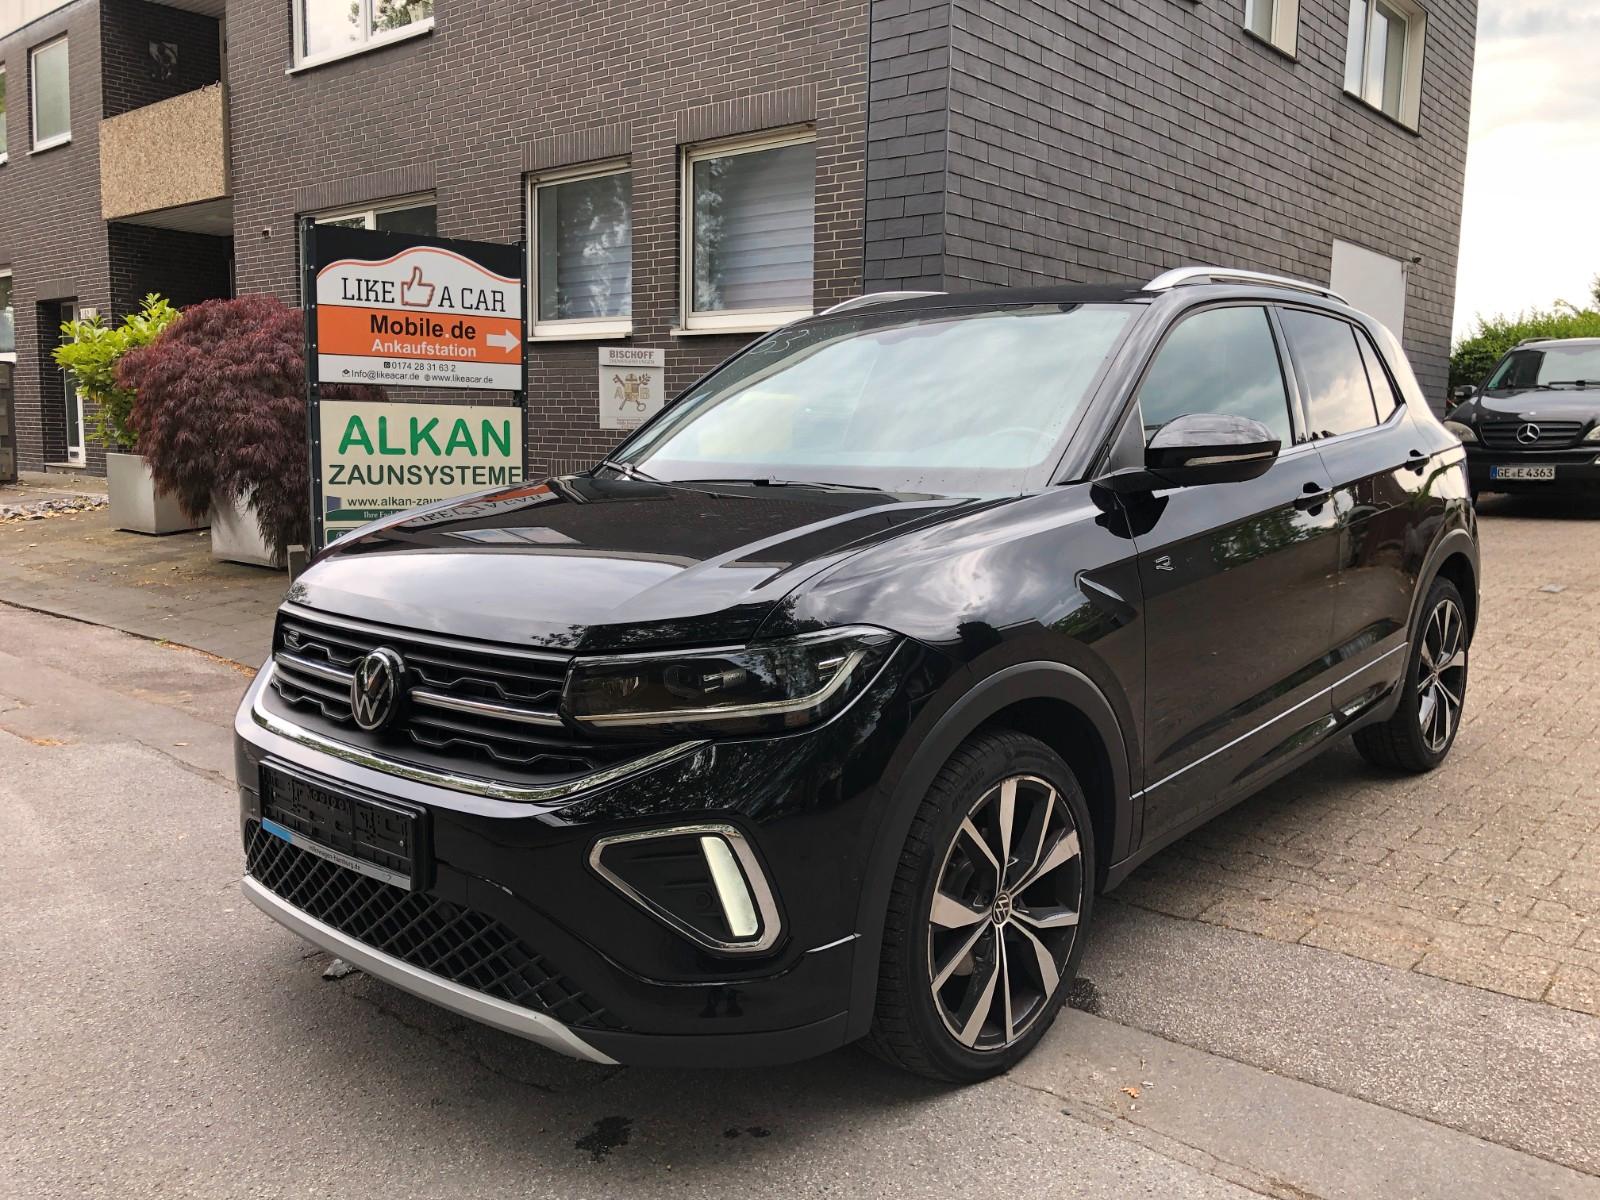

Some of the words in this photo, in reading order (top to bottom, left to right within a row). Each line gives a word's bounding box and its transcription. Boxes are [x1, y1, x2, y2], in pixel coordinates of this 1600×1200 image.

[341, 277, 395, 303] LIKE
[437, 286, 454, 308] A
[461, 288, 506, 312] CAR
[370, 314, 476, 340] Mobile.de
[372, 339, 477, 358] Ankaufstation
[609, 350, 655, 359] BISCHOFF
[391, 361, 412, 370] 0174
[414, 362, 424, 371] 28
[427, 363, 436, 371] 31
[439, 364, 449, 372] 63
[451, 364, 456, 372] 2
[351, 369, 420, 381] Info@likeacar.de
[432, 374, 493, 384] www.likeacar.de
[338, 414, 511, 457] ALKAN
[328, 464, 521, 486] ZAUNSYSTEME
[1498, 468, 1510, 478] GE
[1517, 468, 1524, 478] E
[1526, 468, 1553, 478] 4363
